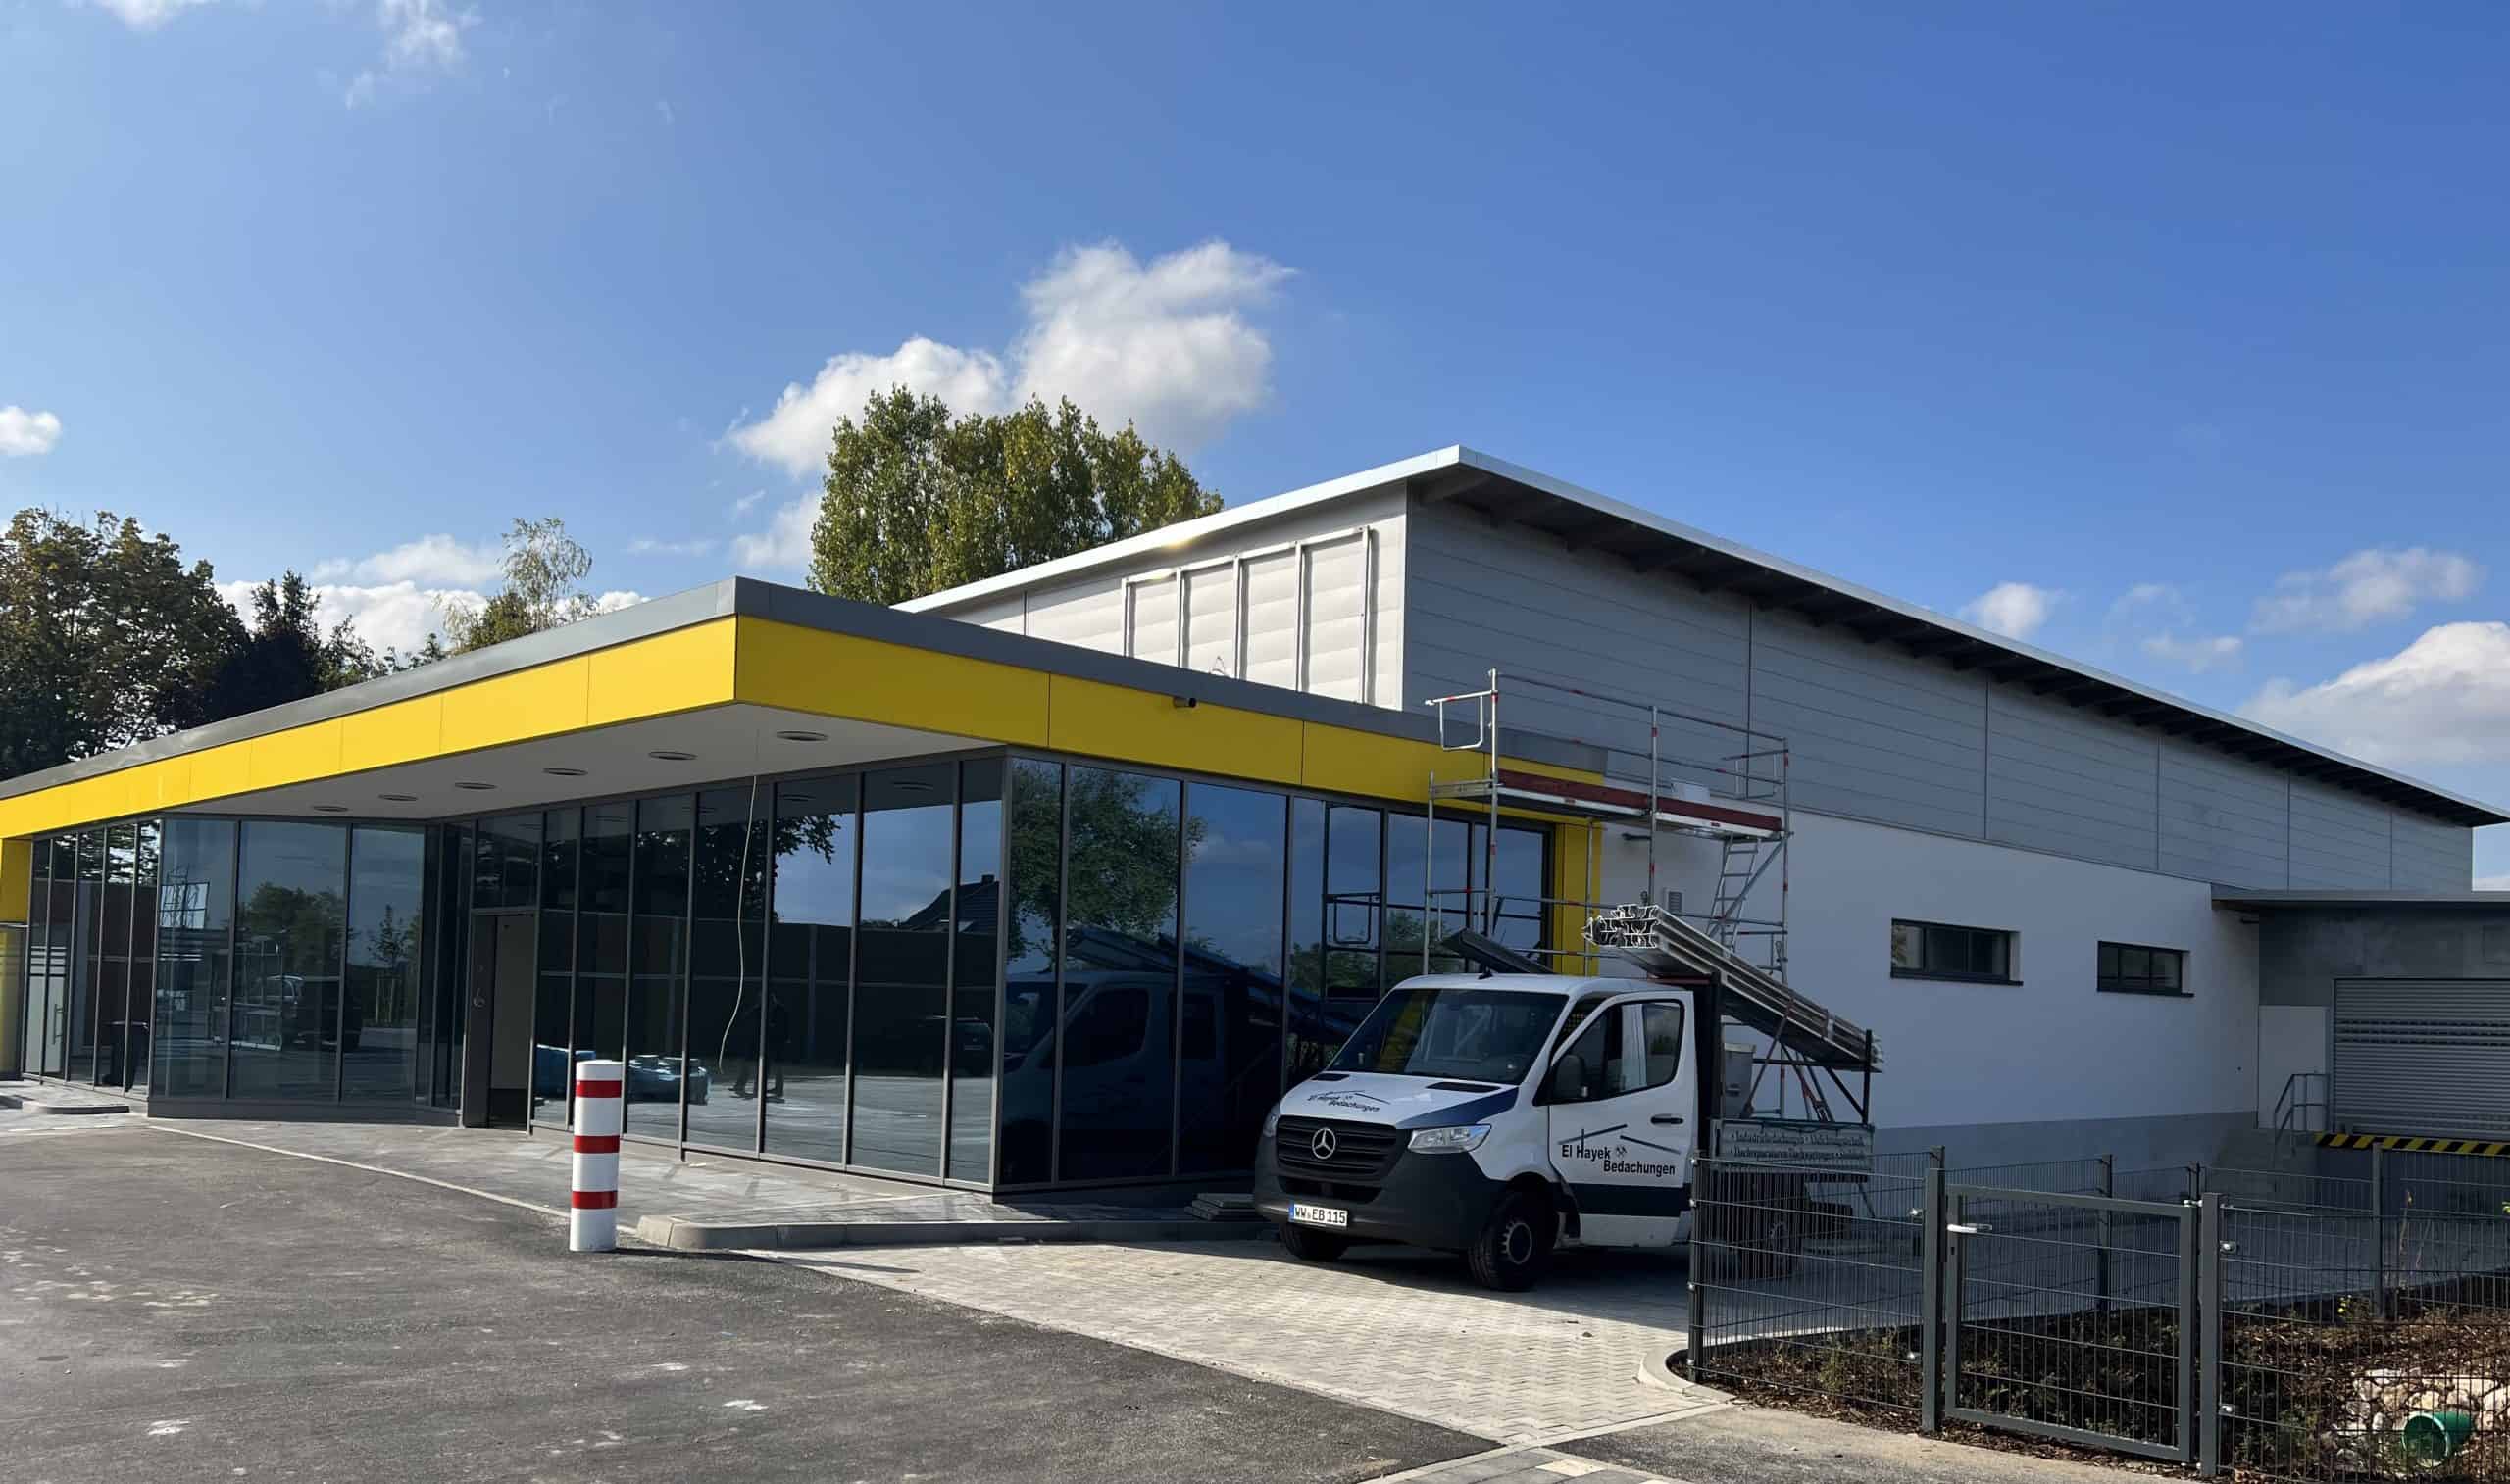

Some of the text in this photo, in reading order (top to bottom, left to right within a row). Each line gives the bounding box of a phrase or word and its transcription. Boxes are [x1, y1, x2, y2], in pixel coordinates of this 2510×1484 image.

[1562, 1145, 1611, 1162] El Hayek
[1603, 1160, 1676, 1177] Bedachungen
[1312, 1208, 1325, 1221] EB
[1327, 1211, 1346, 1223] 115
